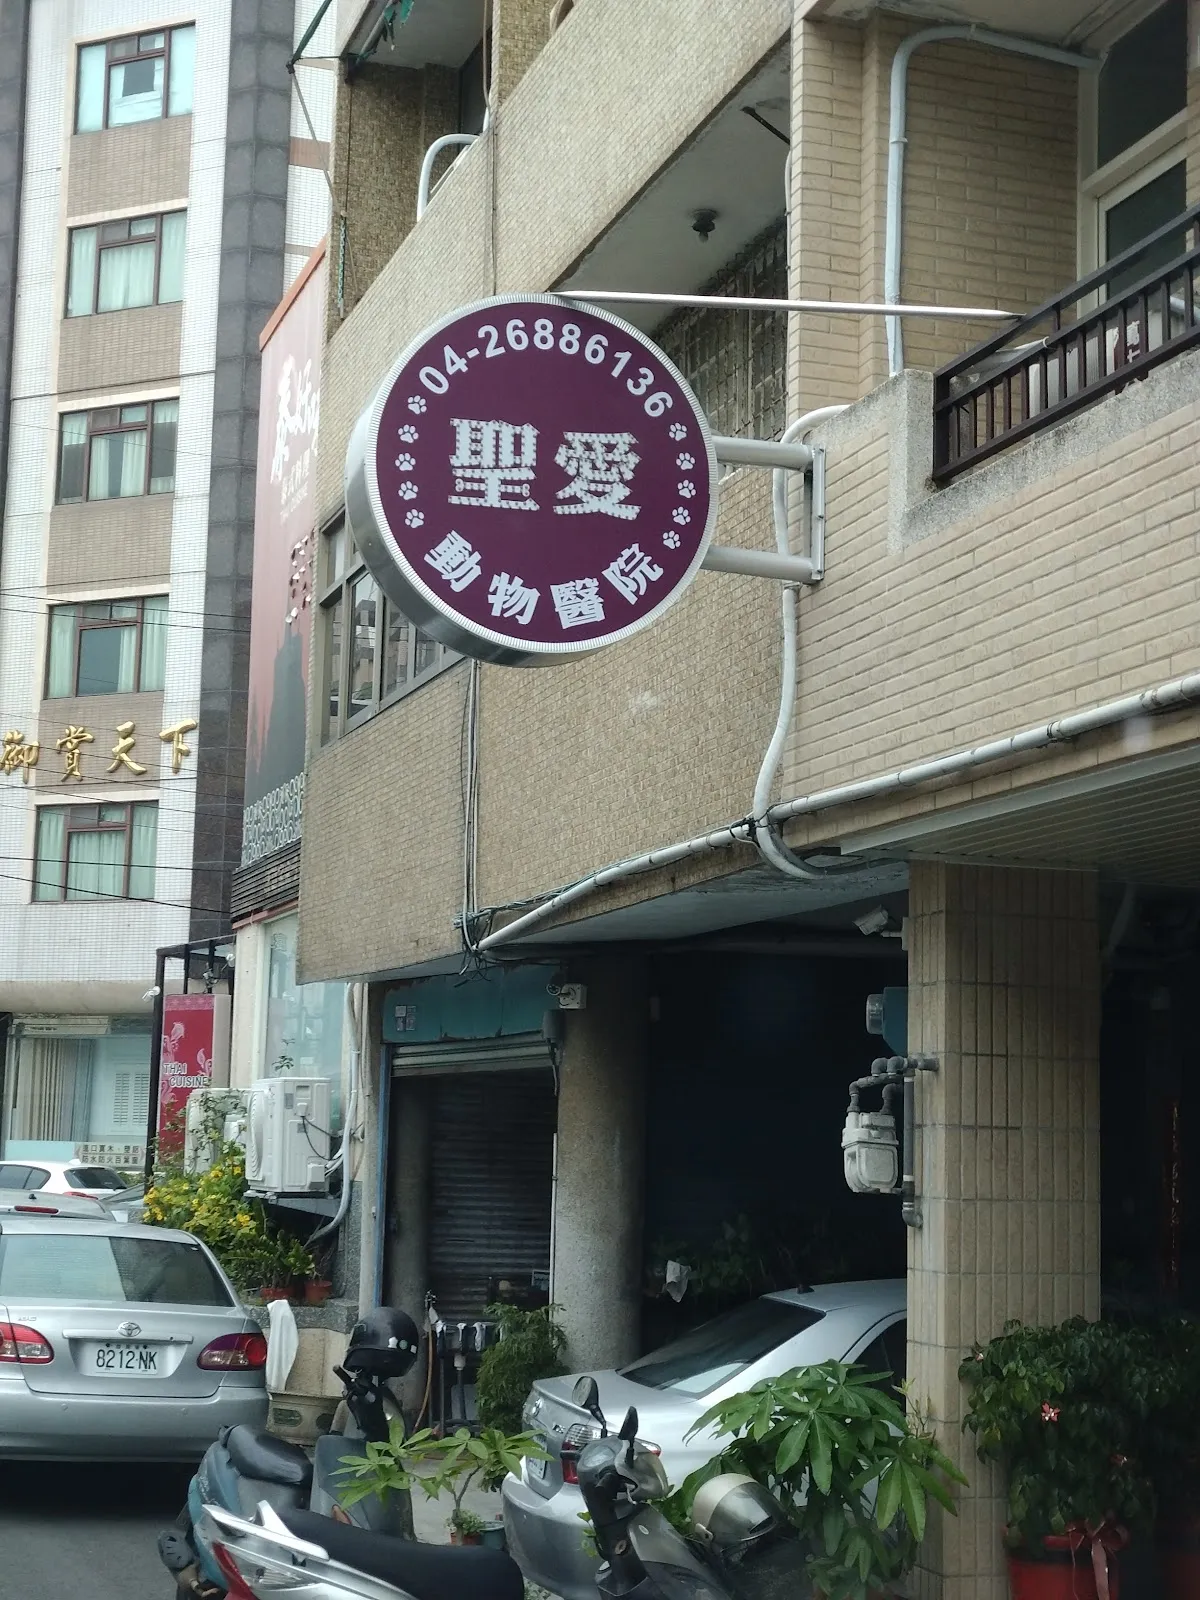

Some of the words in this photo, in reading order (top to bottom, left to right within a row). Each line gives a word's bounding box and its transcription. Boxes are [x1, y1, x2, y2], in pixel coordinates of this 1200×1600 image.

[418, 318, 673, 418] 04-26886136
[448, 418, 642, 520] 聖愛
[423, 530, 664, 629] 動物醫院
[163, 1062, 188, 1075] THAI
[169, 1075, 210, 1088] CUISINE
